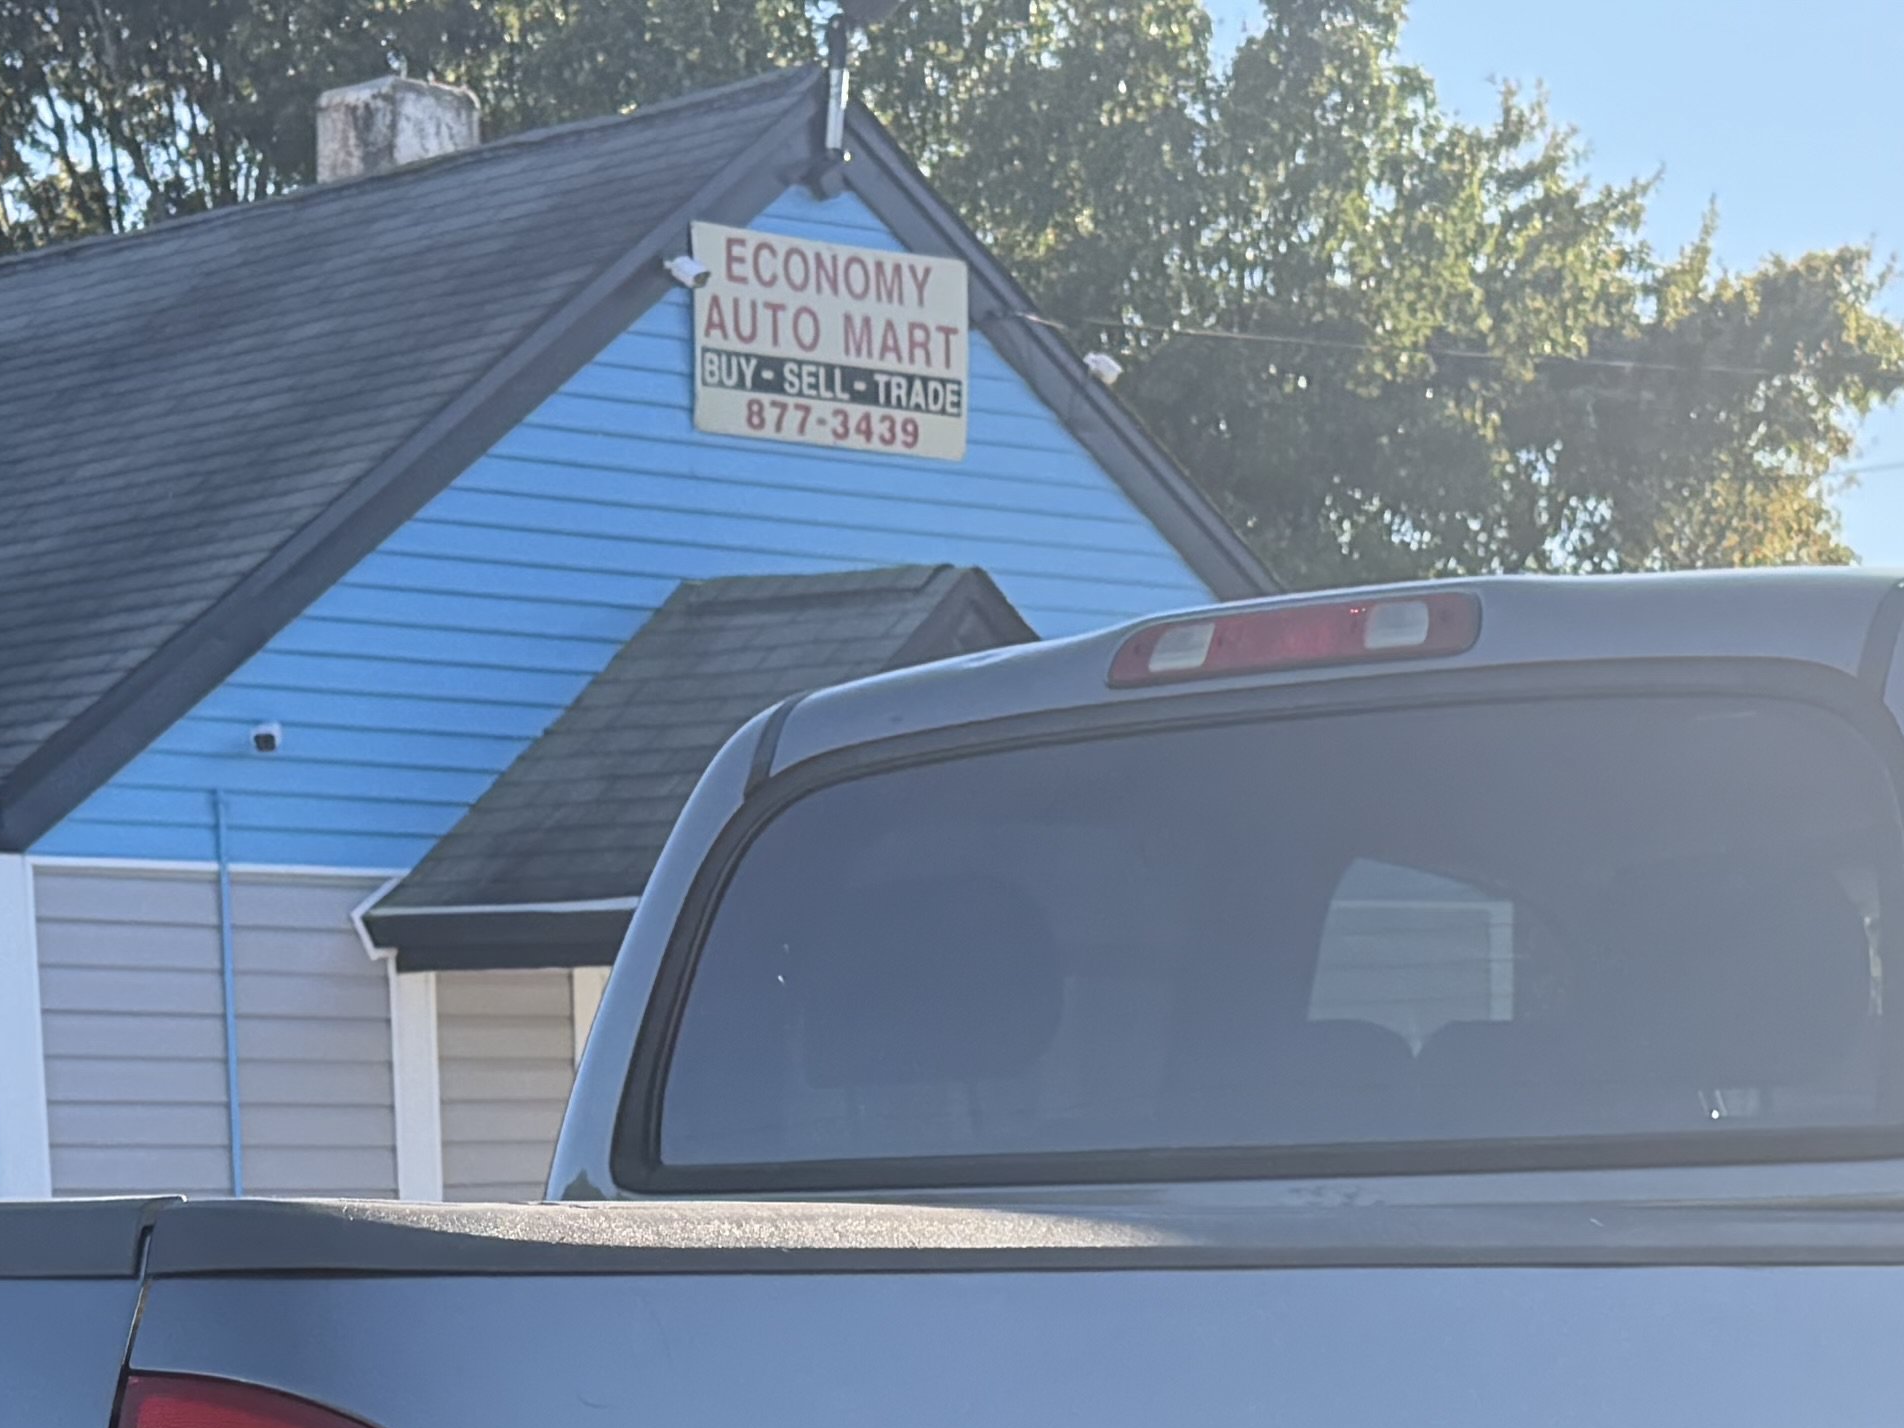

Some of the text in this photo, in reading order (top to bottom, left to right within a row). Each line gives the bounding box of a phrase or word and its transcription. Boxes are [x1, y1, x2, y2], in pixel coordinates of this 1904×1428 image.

[725, 237, 932, 308] ECONOMY
[703, 294, 959, 370] AUTO MART
[703, 352, 758, 389] BUY
[783, 362, 850, 400] SELL
[874, 373, 962, 414] TRADE
[746, 398, 919, 449] 877-3439
